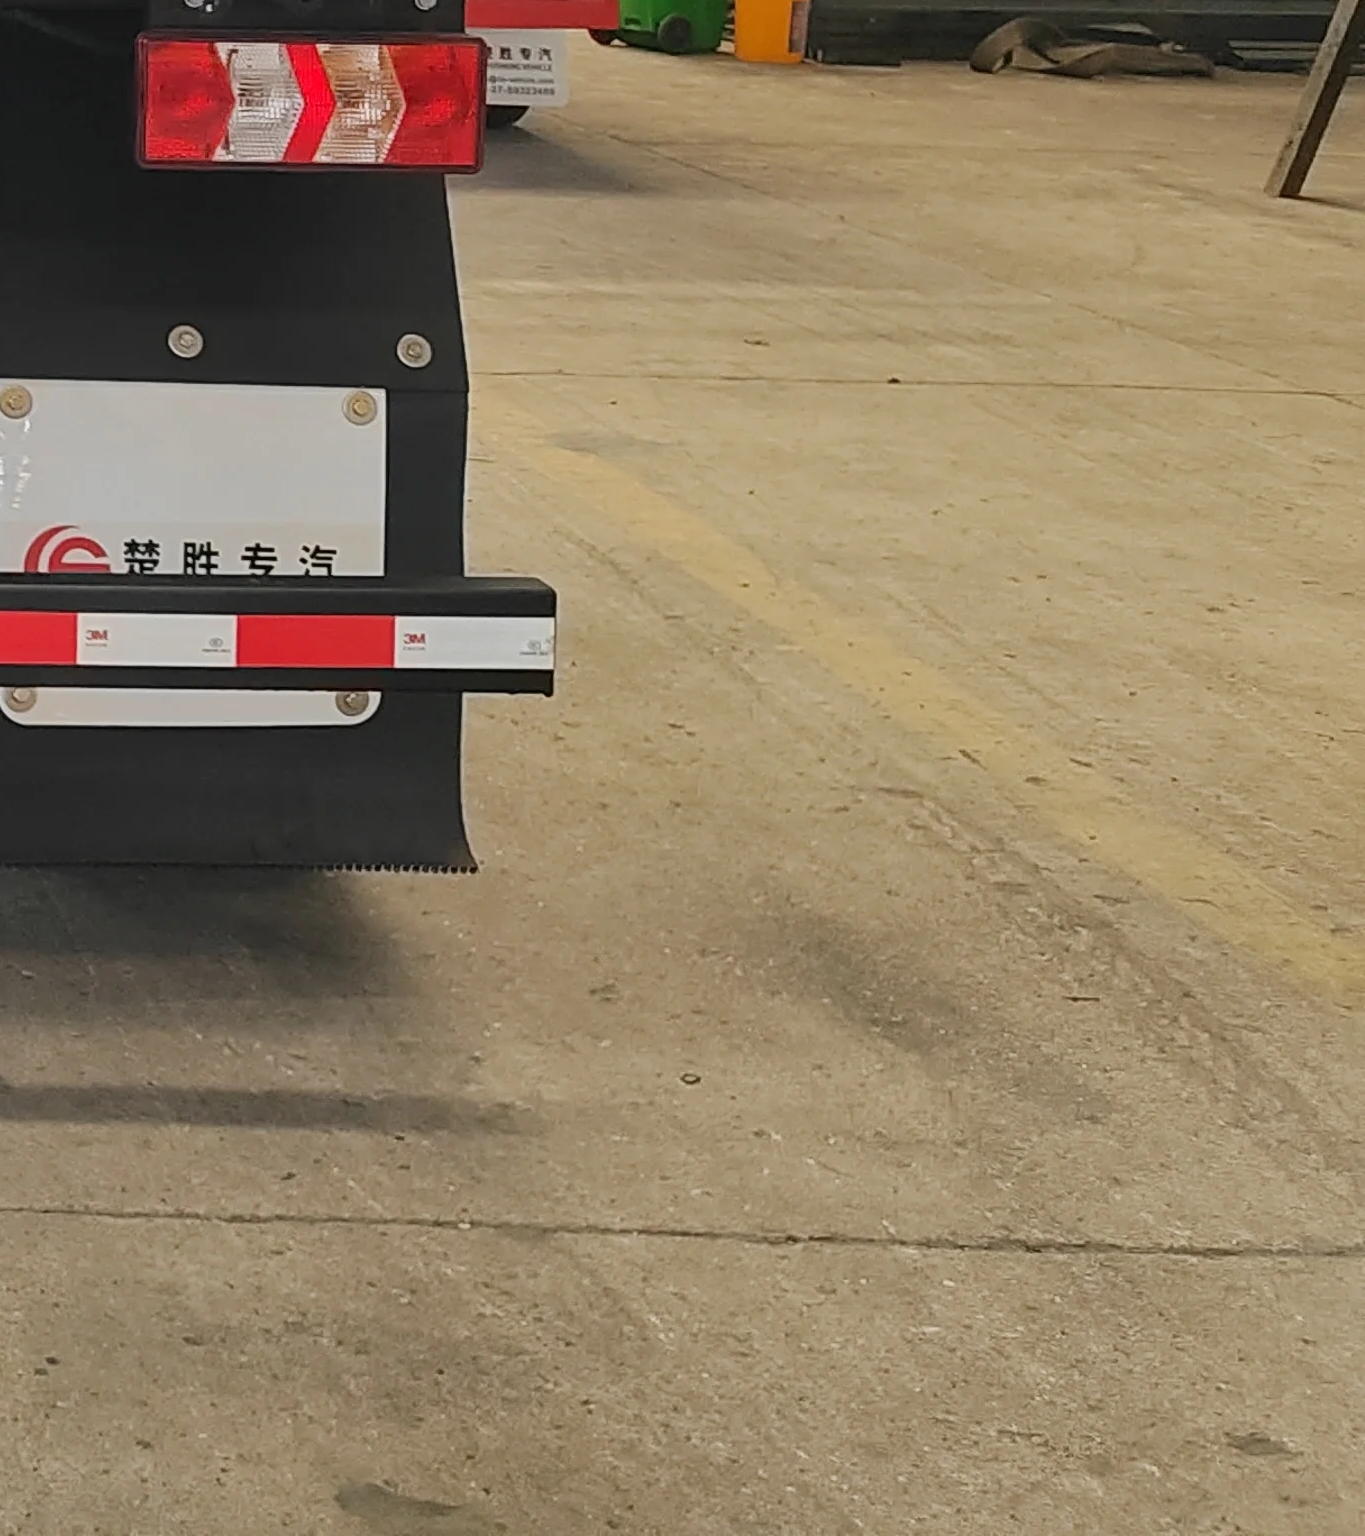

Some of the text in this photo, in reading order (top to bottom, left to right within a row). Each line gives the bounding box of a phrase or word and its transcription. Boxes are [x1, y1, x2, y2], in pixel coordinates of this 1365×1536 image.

[123, 538, 338, 577] 楚胜专汽
[85, 629, 109, 641] 3M
[403, 633, 427, 645] 3M
